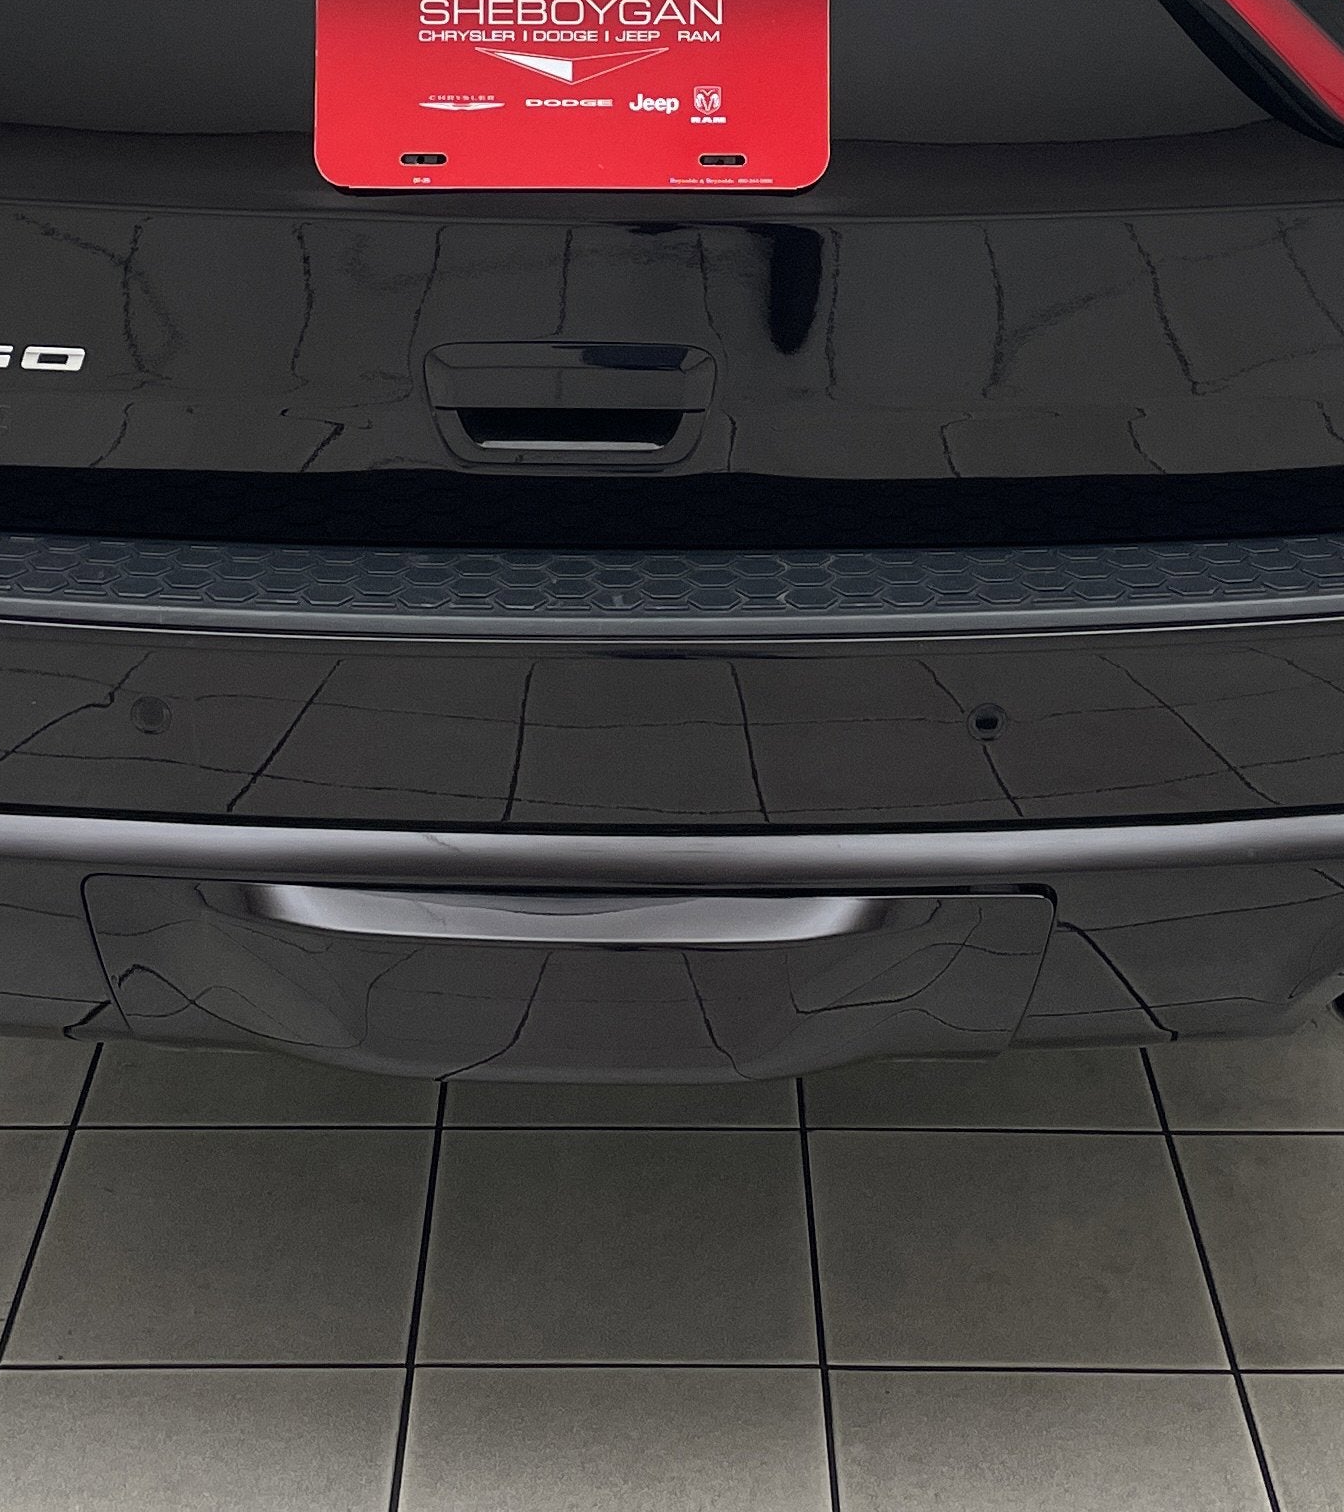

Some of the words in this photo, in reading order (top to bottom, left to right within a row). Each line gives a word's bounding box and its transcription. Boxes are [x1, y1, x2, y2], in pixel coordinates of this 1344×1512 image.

[418, 29, 517, 43] CHRYSLER
[532, 29, 599, 43] DODGE
[614, 29, 662, 43] JEEP
[676, 29, 722, 43] RAM
[524, 98, 613, 108] DODGE
[628, 93, 681, 115] Jeep
[690, 116, 727, 125] RAM
